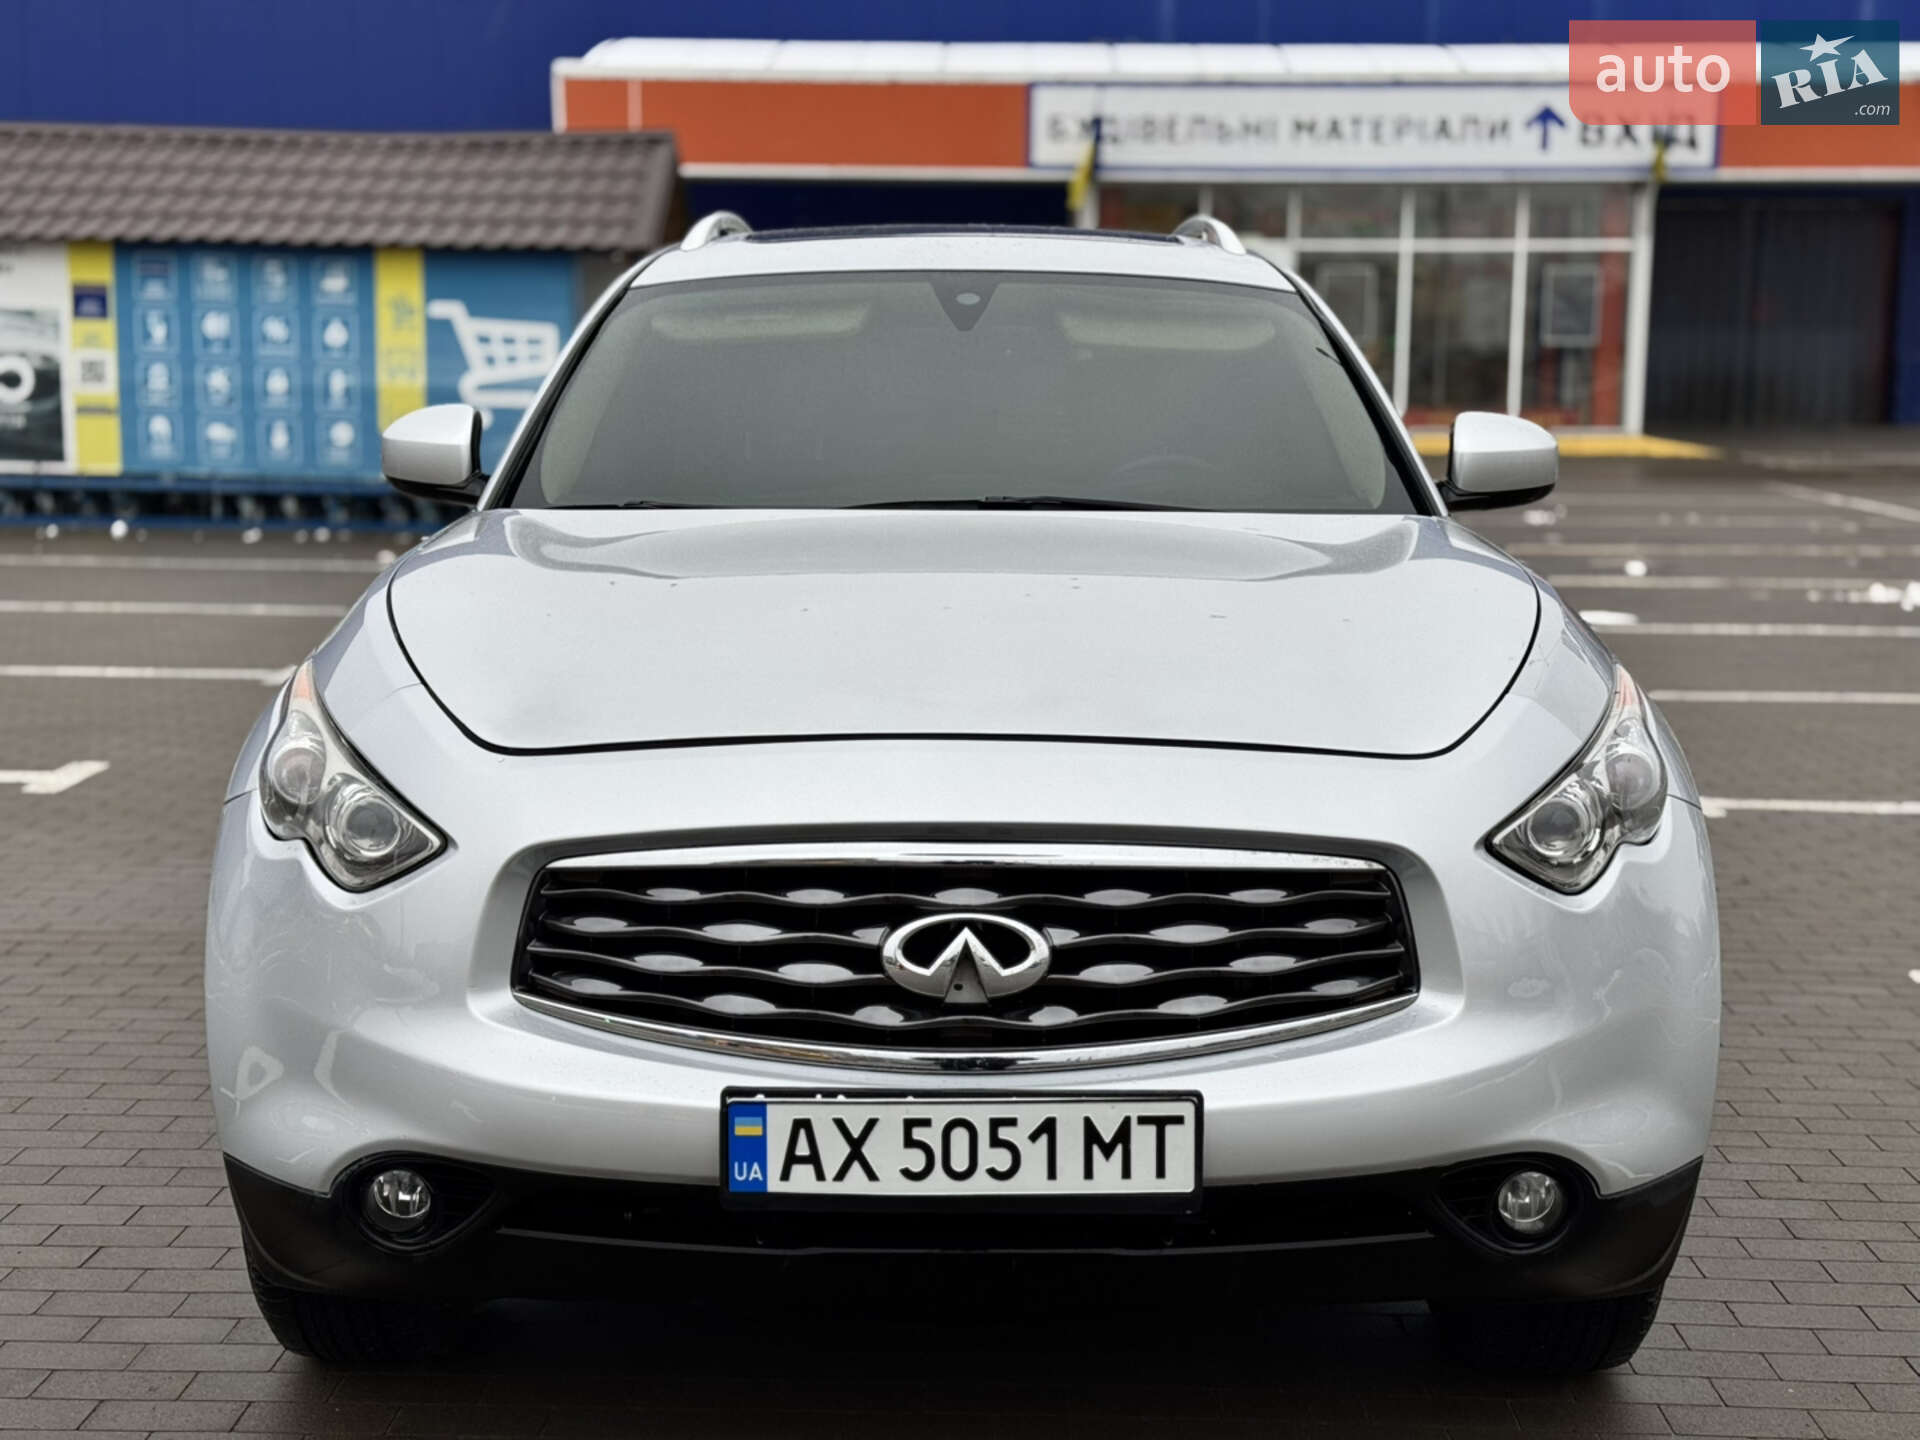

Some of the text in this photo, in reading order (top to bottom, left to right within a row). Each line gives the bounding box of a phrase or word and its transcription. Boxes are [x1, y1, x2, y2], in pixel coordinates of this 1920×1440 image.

[1291, 114, 1512, 144] МАТЕРІАЛИ
[779, 1115, 1186, 1182] AX 5051 MT
[733, 1161, 764, 1182] UA
